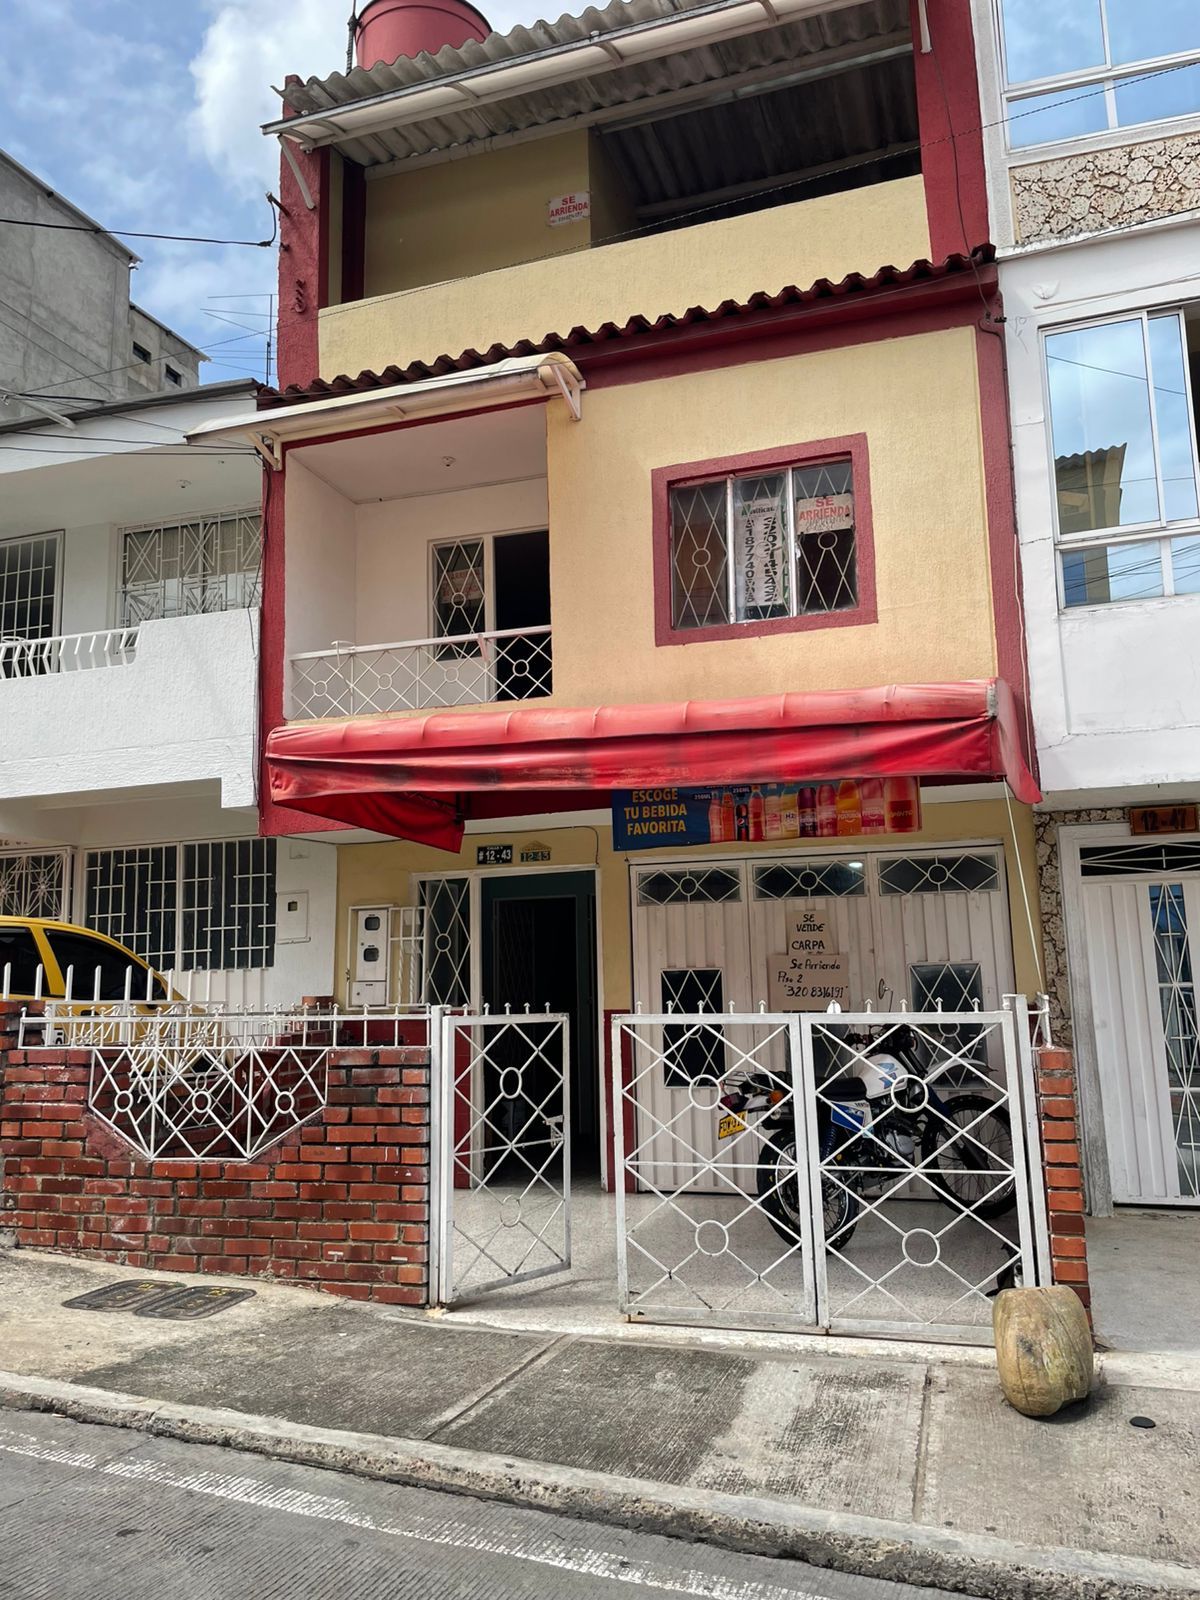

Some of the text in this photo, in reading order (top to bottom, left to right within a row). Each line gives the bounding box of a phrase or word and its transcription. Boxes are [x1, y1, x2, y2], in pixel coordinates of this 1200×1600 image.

[562, 196, 576, 206] SE
[550, 202, 589, 217] ARRIENDA
[815, 497, 834, 508] SE
[799, 505, 851, 520] ARRIENDA
[632, 787, 678, 803] ESCOGE
[624, 804, 687, 820] TU BEBIDA
[627, 820, 686, 835] FAVORITA
[803, 914, 815, 922] SE
[796, 923, 825, 932] VENDE
[791, 940, 825, 950] CARPA
[790, 959, 802, 970] Se
[796, 974, 803, 983] 2
